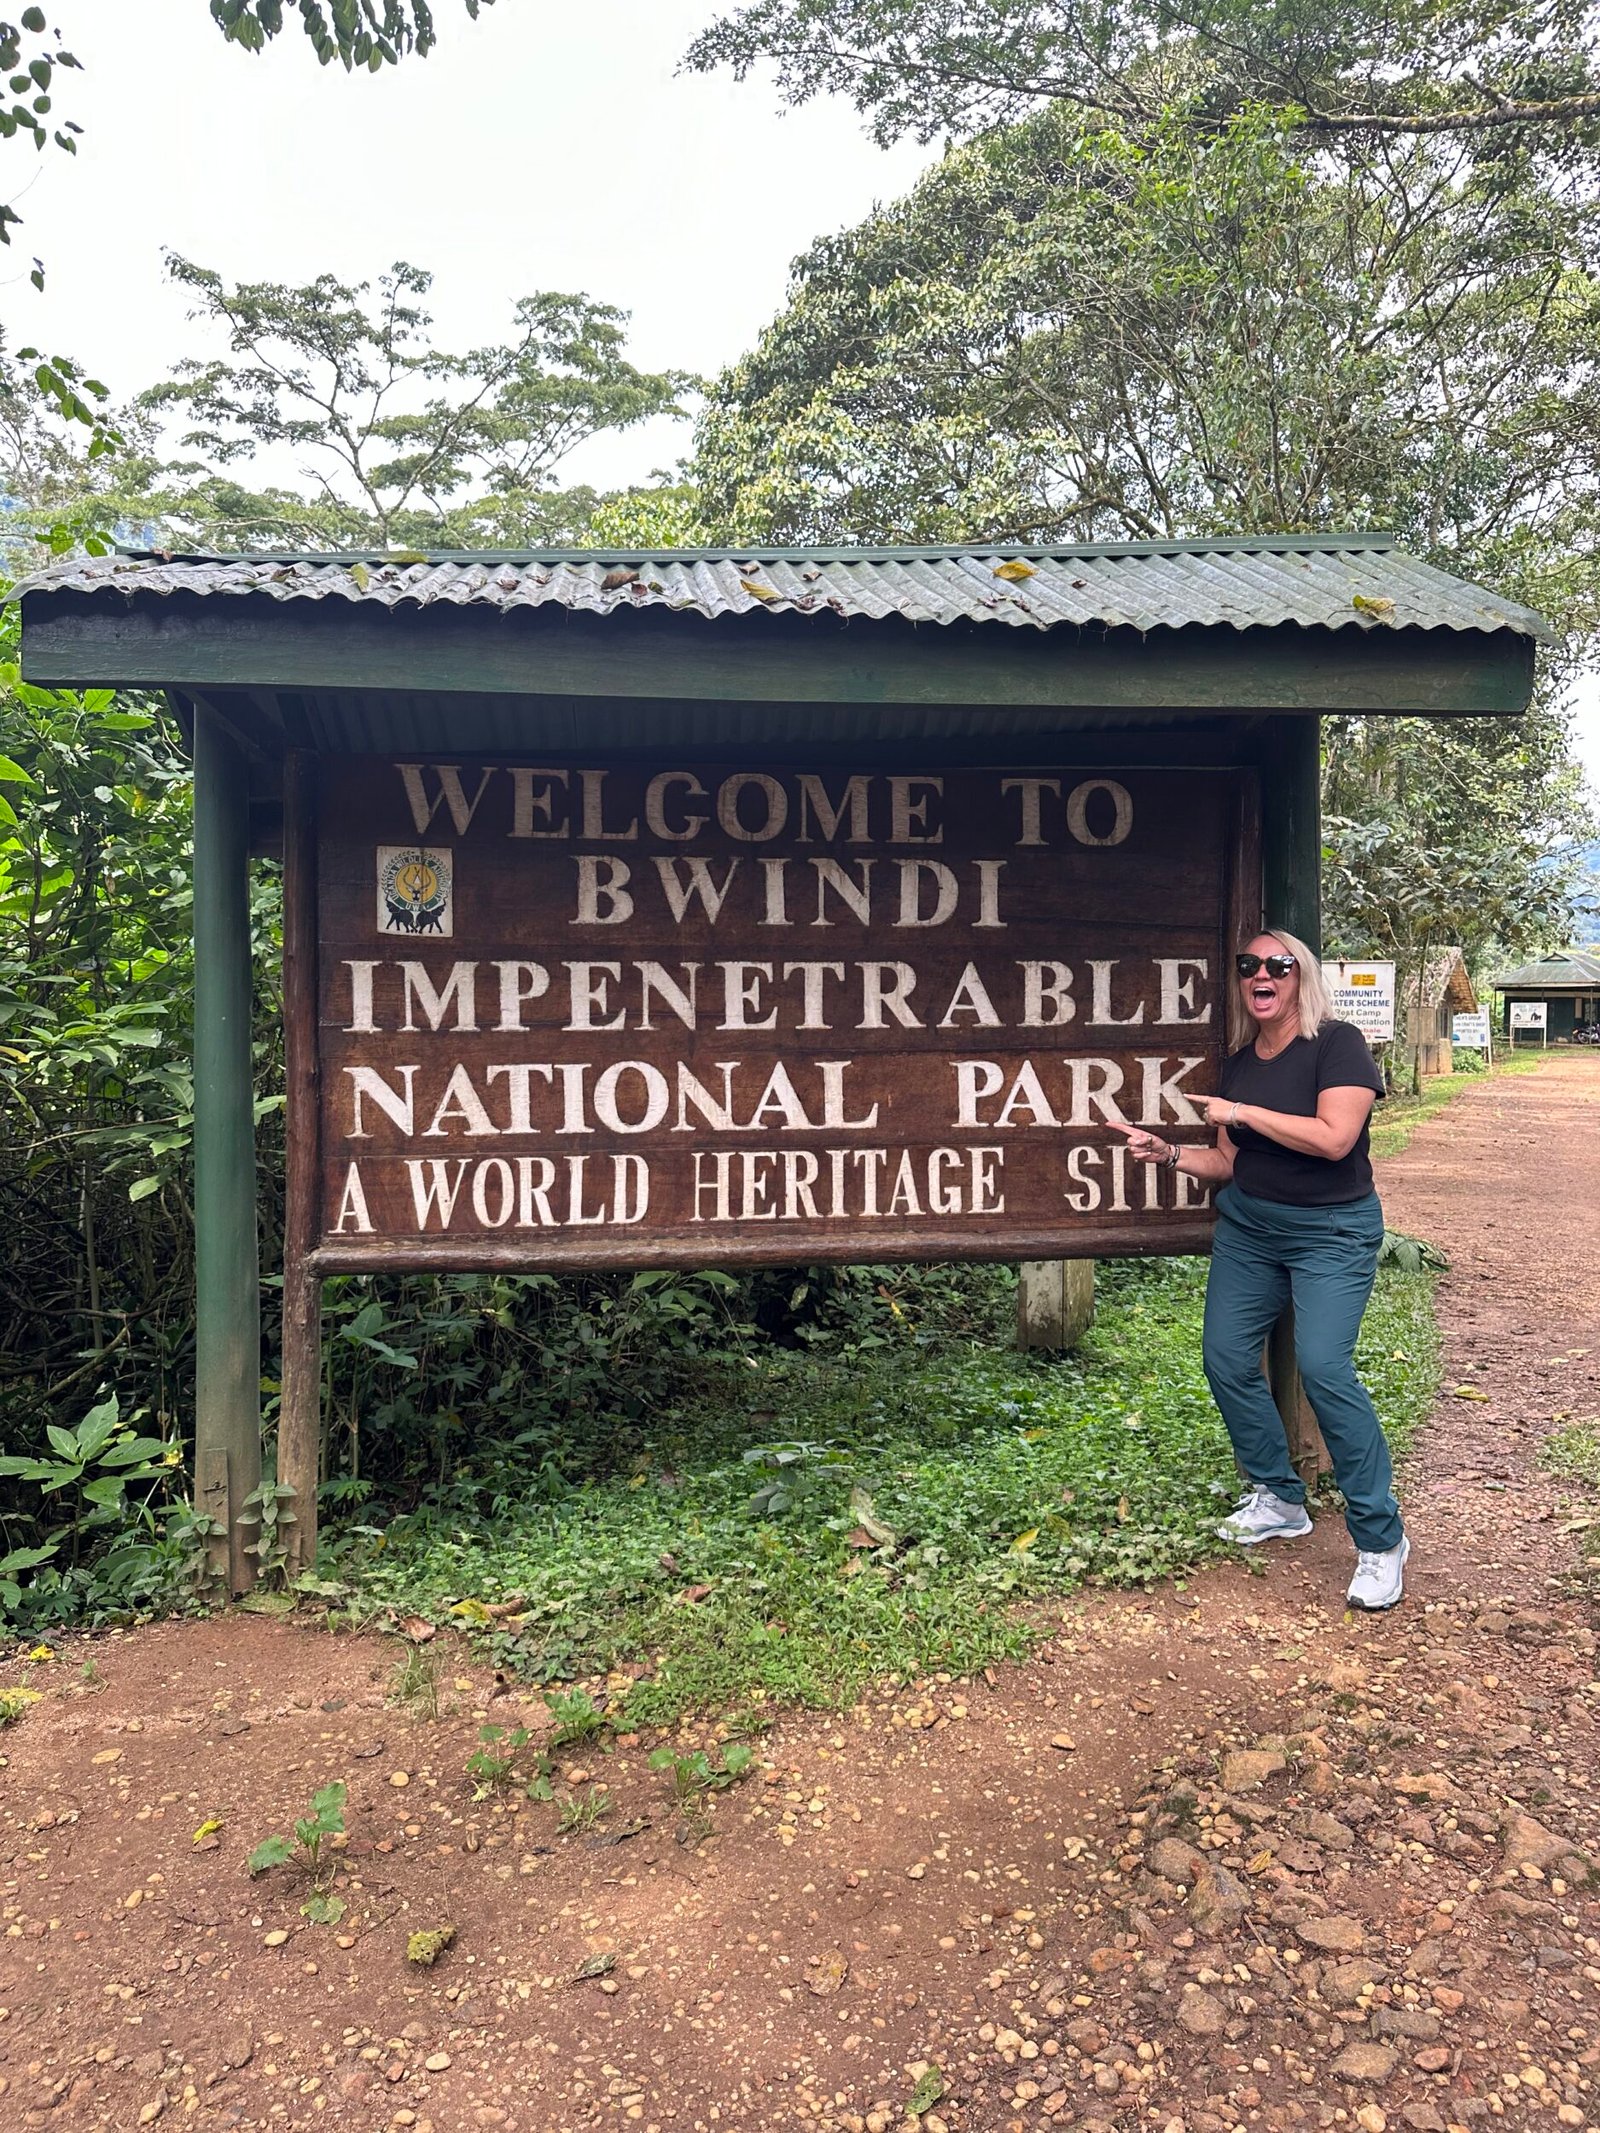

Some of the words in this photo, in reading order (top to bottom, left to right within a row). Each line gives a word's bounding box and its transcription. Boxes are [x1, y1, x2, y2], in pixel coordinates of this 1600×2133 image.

[394, 763, 944, 844] WELCOME
[1001, 778, 1133, 847] TO
[569, 855, 1008, 928] BWINDI
[341, 958, 1211, 1033] IMPENETRABLE
[1356, 1009, 1381, 1017] Camp
[343, 1060, 879, 1137] NATIONAL
[949, 1057, 1206, 1128] PARK
[328, 1161, 377, 1233] A
[404, 1154, 650, 1230] WORLD
[691, 1146, 1005, 1221] HERITAGE
